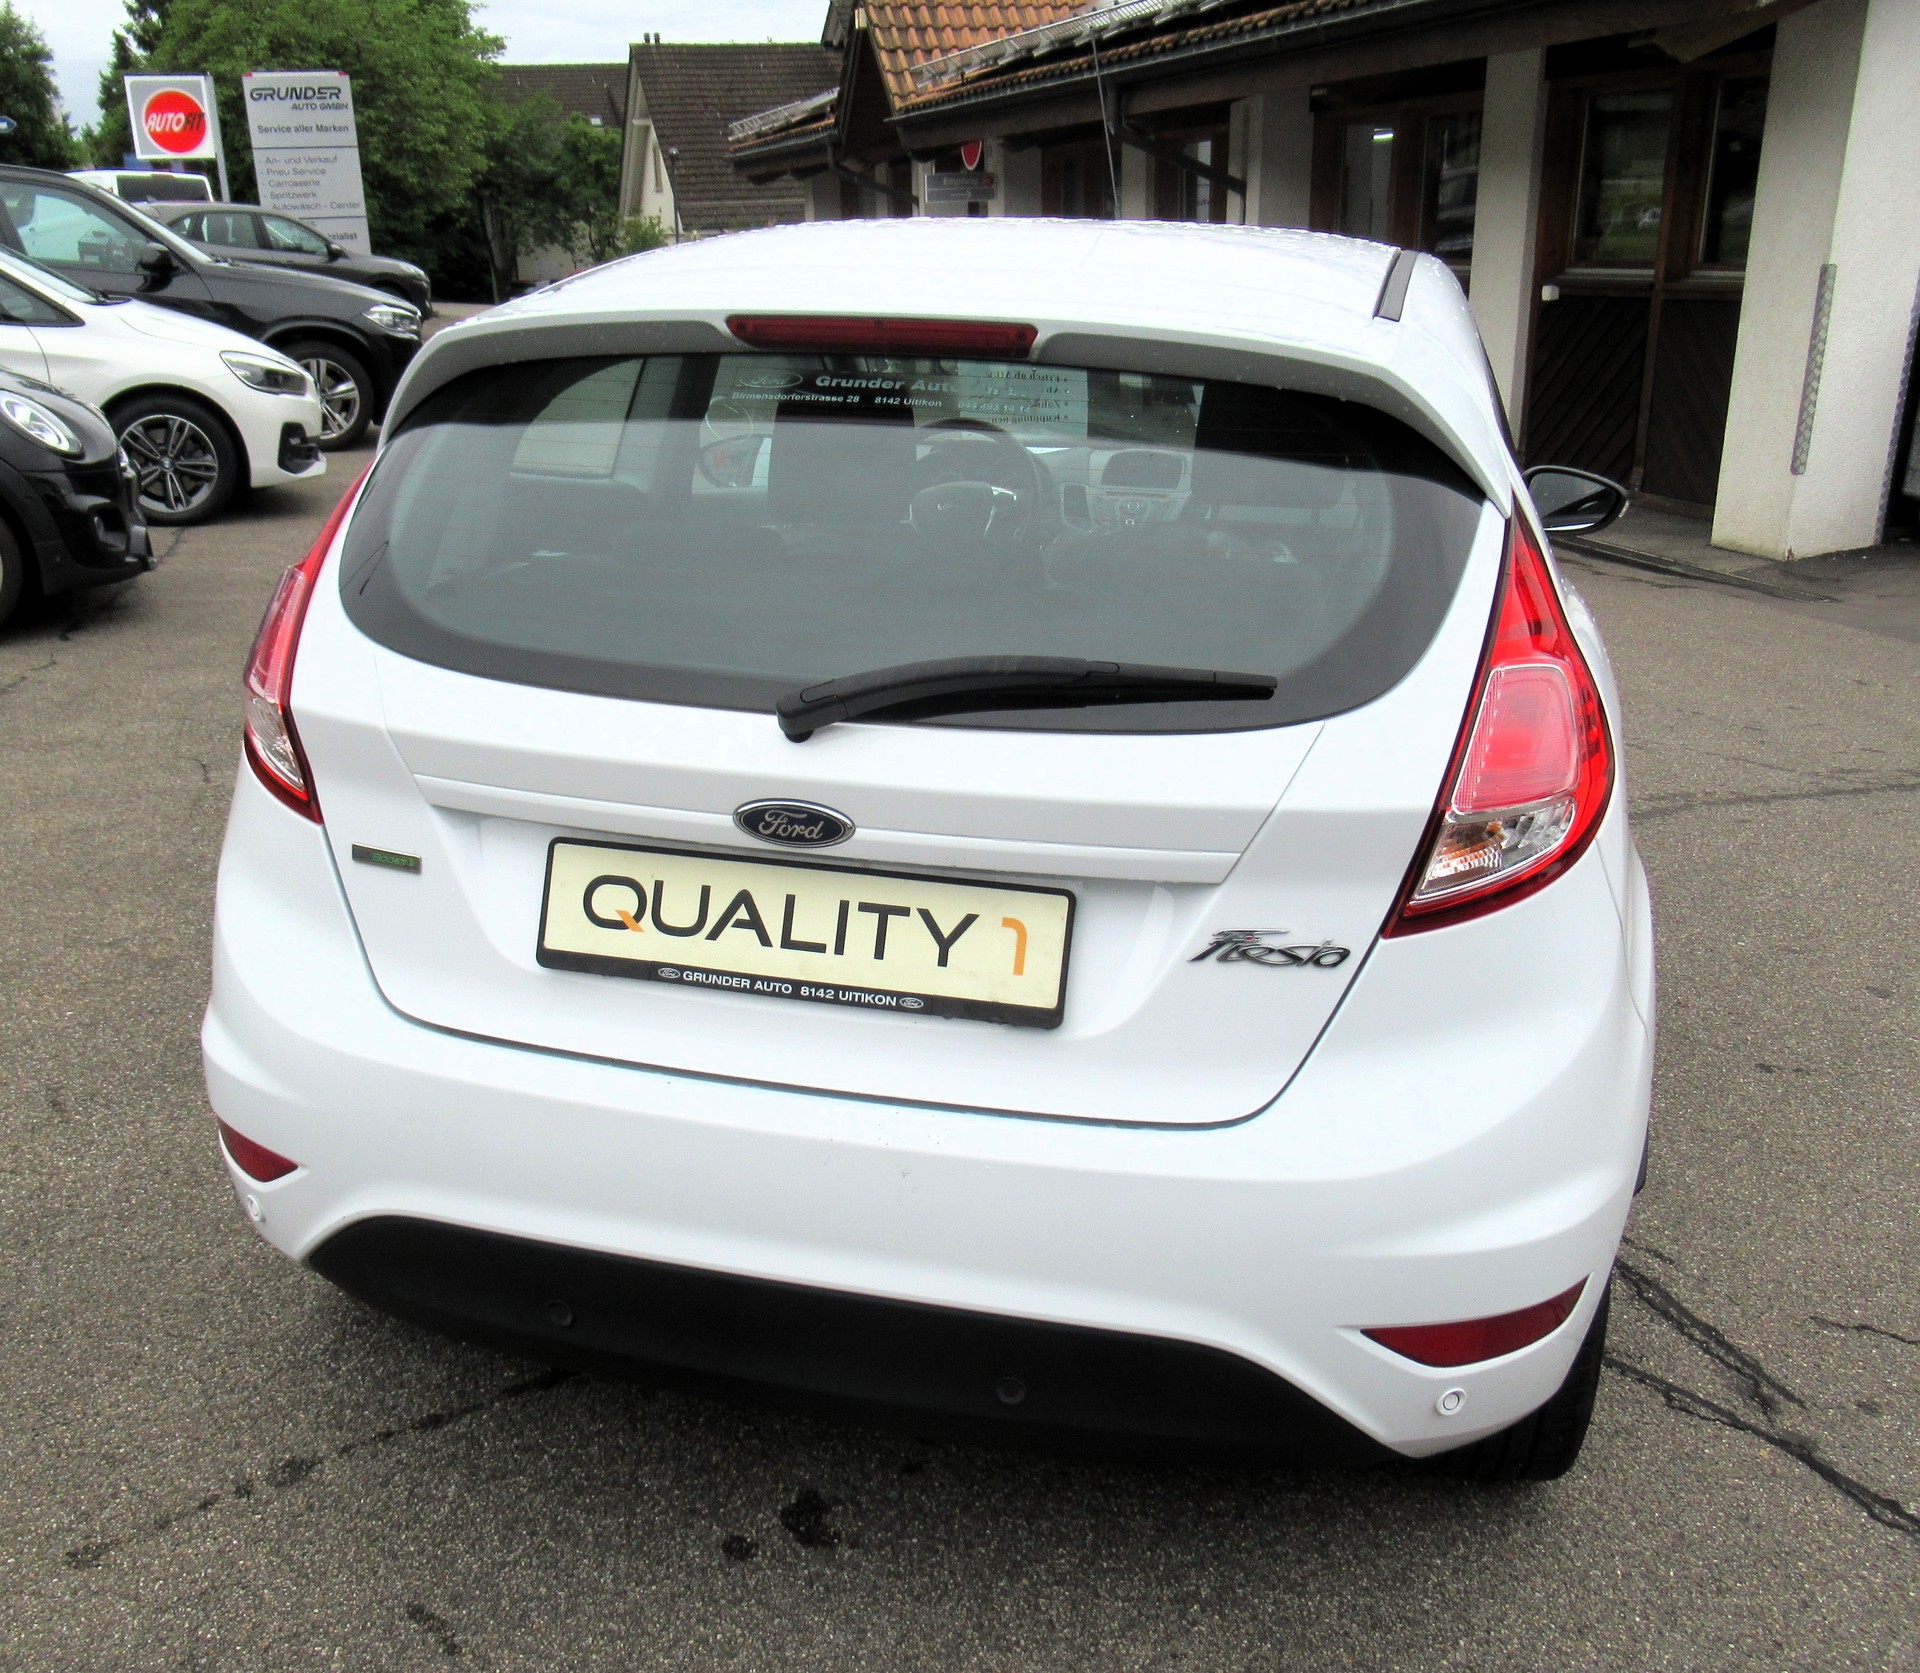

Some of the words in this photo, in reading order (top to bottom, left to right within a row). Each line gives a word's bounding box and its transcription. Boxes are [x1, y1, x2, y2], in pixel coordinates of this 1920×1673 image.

[249, 86, 342, 101] GRUNDER
[291, 102, 318, 111] AUTO
[319, 102, 349, 111] GMBH
[257, 124, 292, 134] Service
[294, 124, 314, 133] aller
[316, 123, 349, 133] Marken
[284, 156, 302, 164] und
[303, 155, 338, 164] Verkauf
[266, 167, 290, 176] Pneu
[292, 167, 327, 176] Service
[268, 179, 321, 188] Carrosserie
[269, 191, 318, 200] Spritzwerk
[272, 202, 322, 211] Autowasch
[330, 201, 360, 210] Center
[815, 375, 905, 391] Grunder
[731, 391, 844, 403] Birmensdorferstrasse
[846, 394, 860, 403] 28
[874, 395, 901, 405] 8142
[903, 397, 943, 407] Uitikon
[758, 809, 825, 840] Ford
[582, 874, 980, 968] QUALITY
[1187, 928, 1351, 967] Fiesta
[682, 970, 751, 989] GRUNDER
[753, 980, 793, 994] AUTO
[800, 985, 835, 999] 8142
[838, 990, 897, 1007] UITIKON
